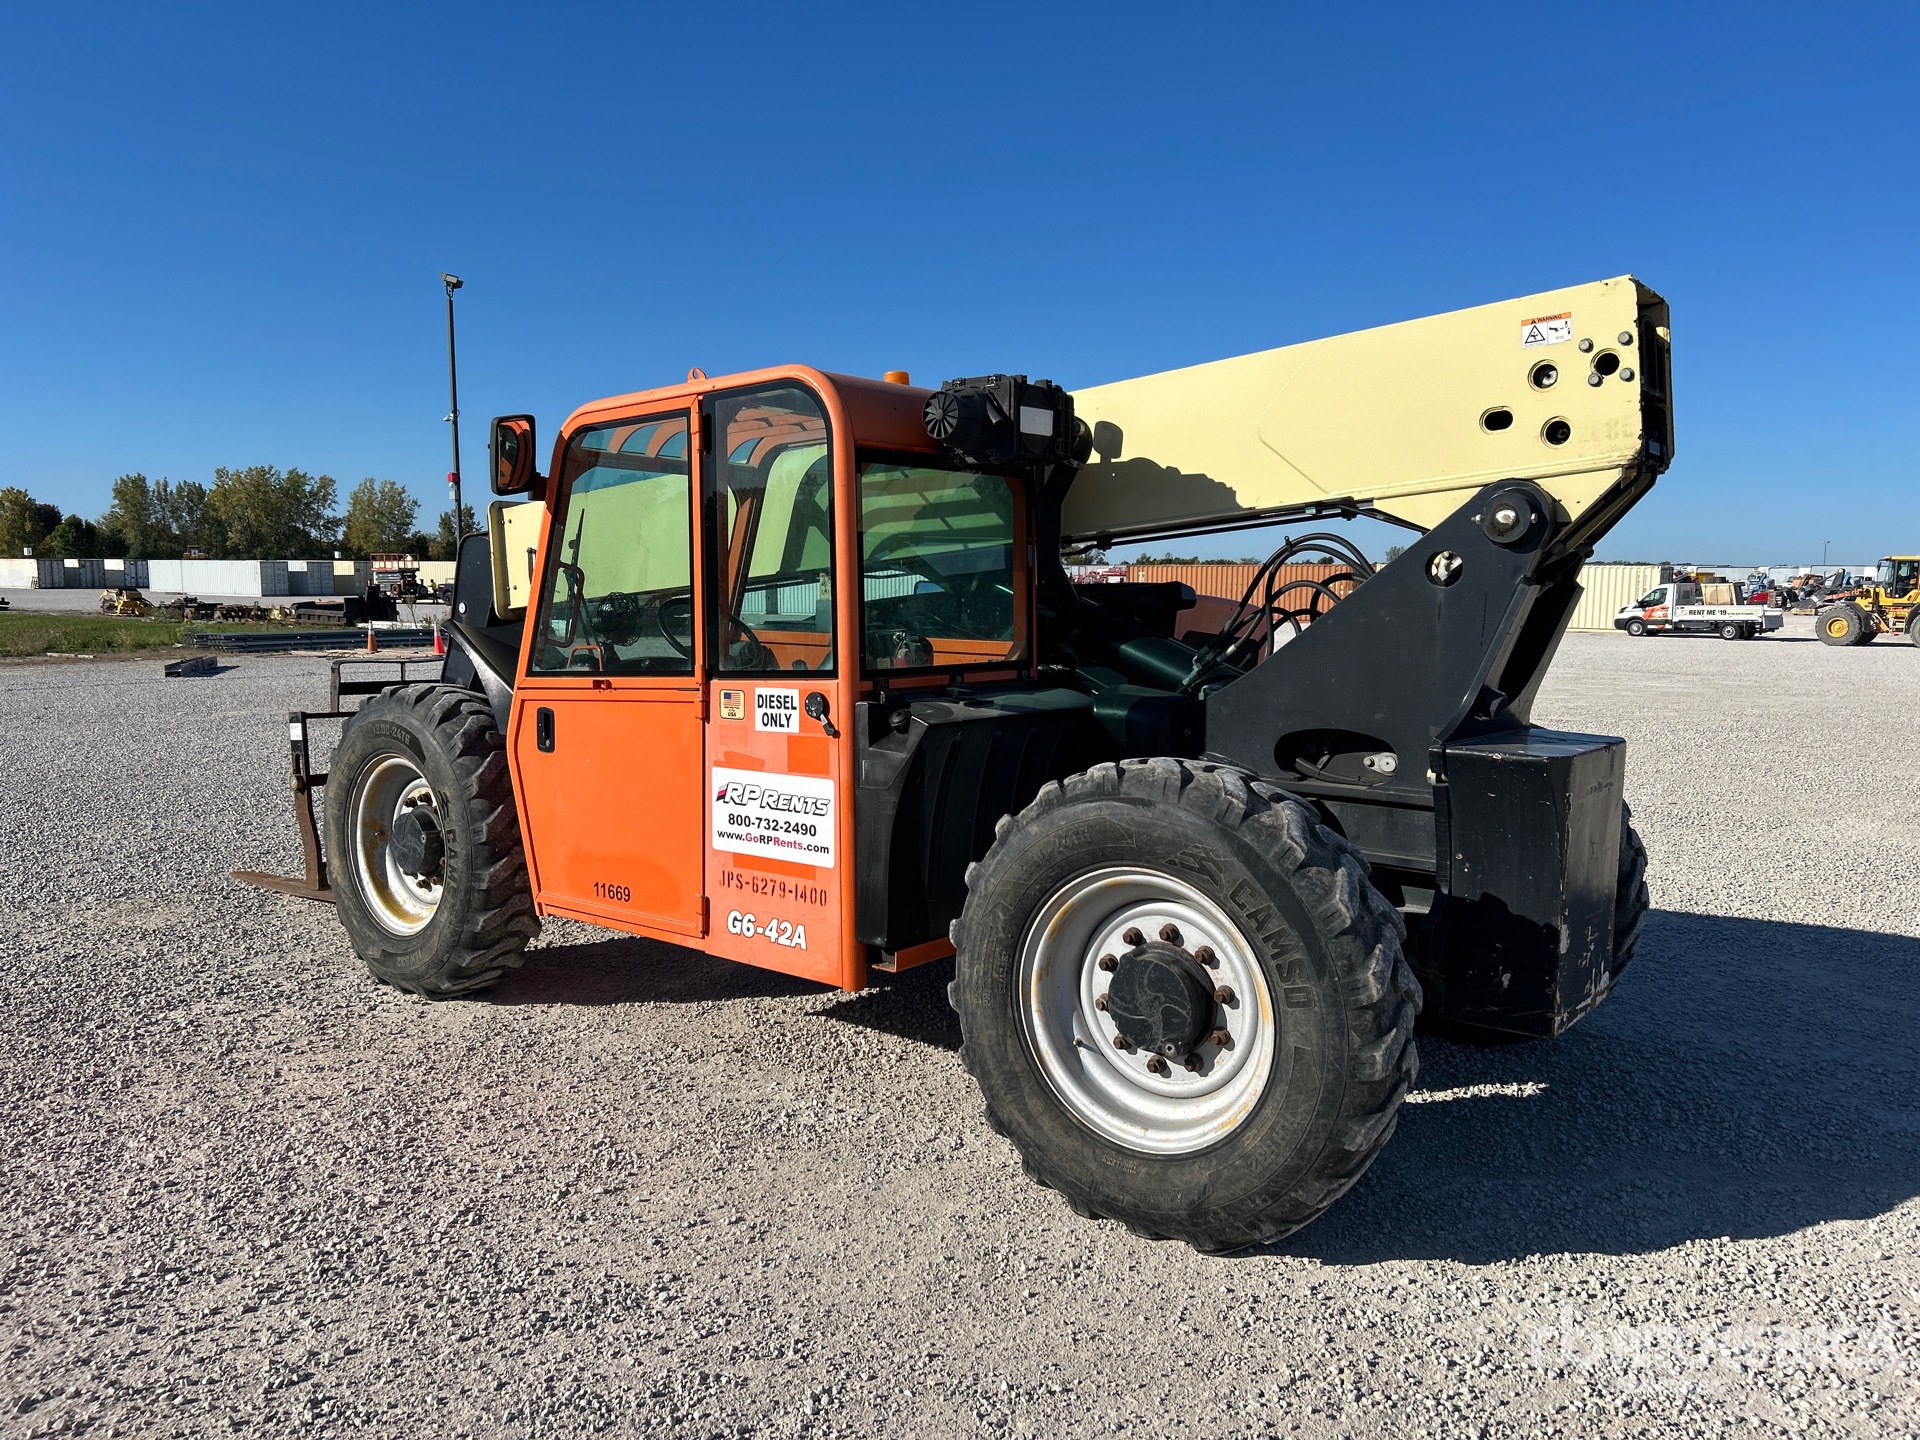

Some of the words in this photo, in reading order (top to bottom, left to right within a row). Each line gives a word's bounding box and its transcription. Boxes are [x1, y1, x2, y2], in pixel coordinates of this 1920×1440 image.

[1537, 314, 1562, 323] WARNING
[757, 694, 797, 711] DIESEL
[762, 712, 792, 728] ONLY
[723, 782, 762, 806] RP
[760, 789, 831, 816] RENTS
[728, 813, 817, 837] 800-732-2490
[717, 830, 830, 854] www.GoRPRents.com
[593, 881, 631, 903] 11669
[727, 909, 808, 952] G6-42A
[1228, 876, 1316, 1011] CAMSO
